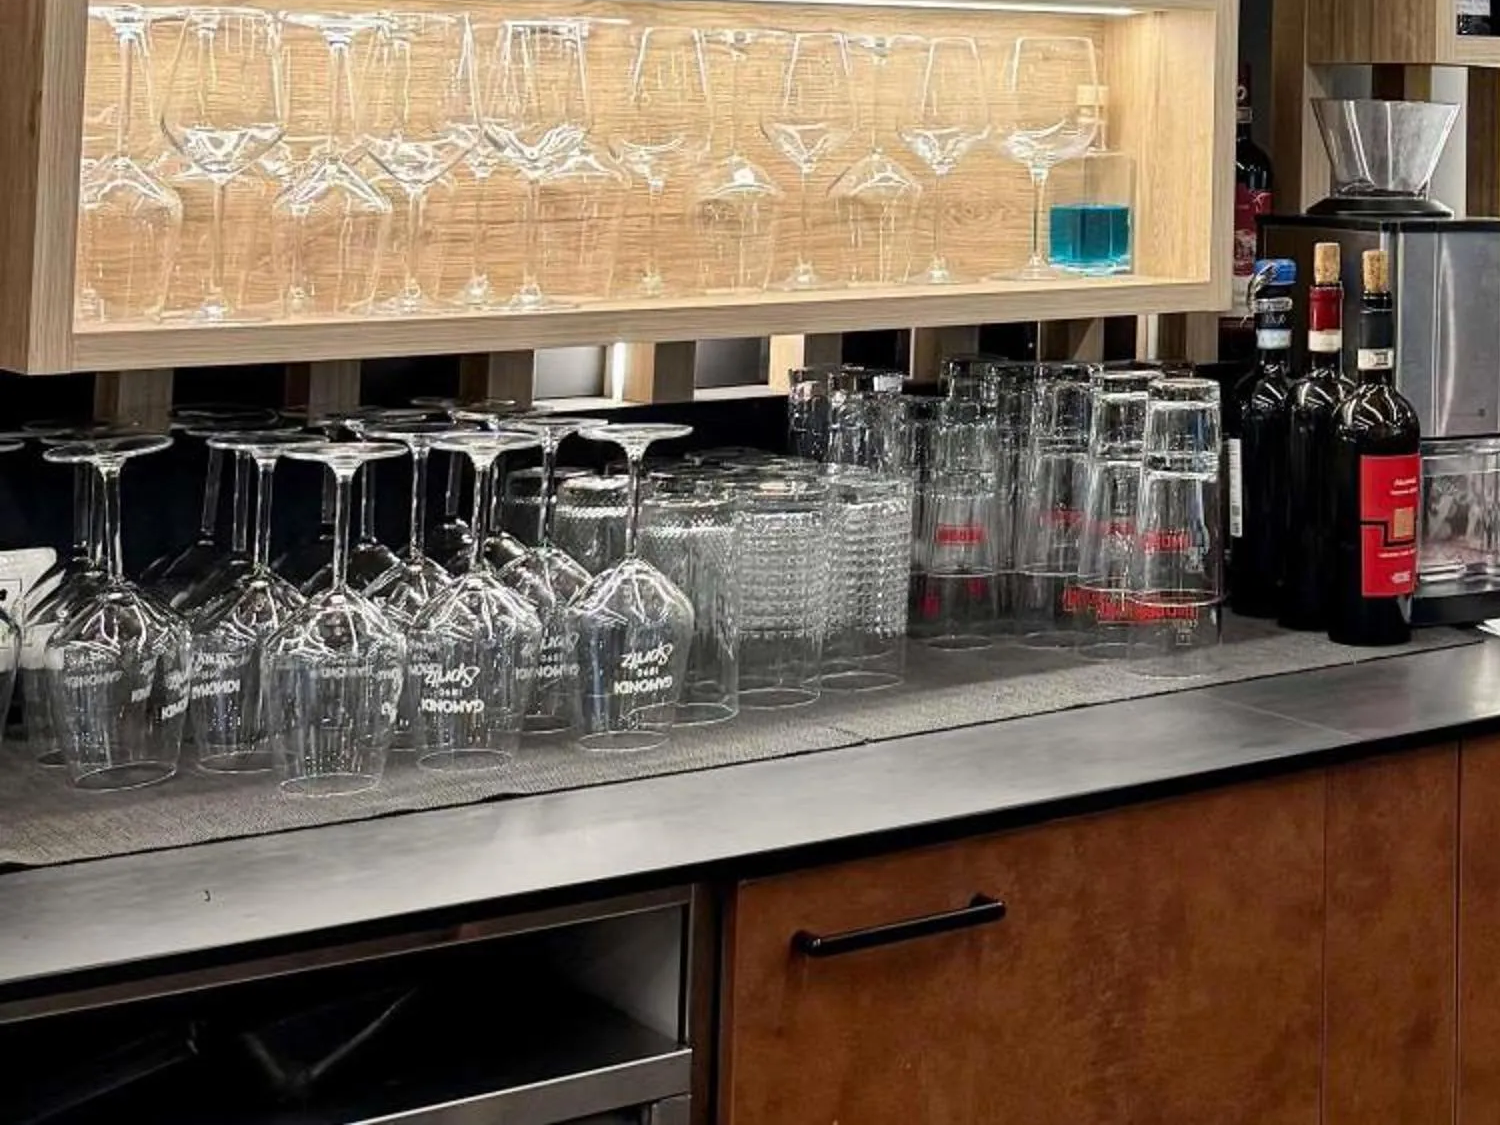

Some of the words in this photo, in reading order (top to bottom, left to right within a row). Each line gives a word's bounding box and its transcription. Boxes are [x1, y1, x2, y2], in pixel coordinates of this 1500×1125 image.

[620, 642, 674, 669] Spritz
[612, 676, 674, 695] GAMONDI
[421, 698, 485, 714] GAMONDI
